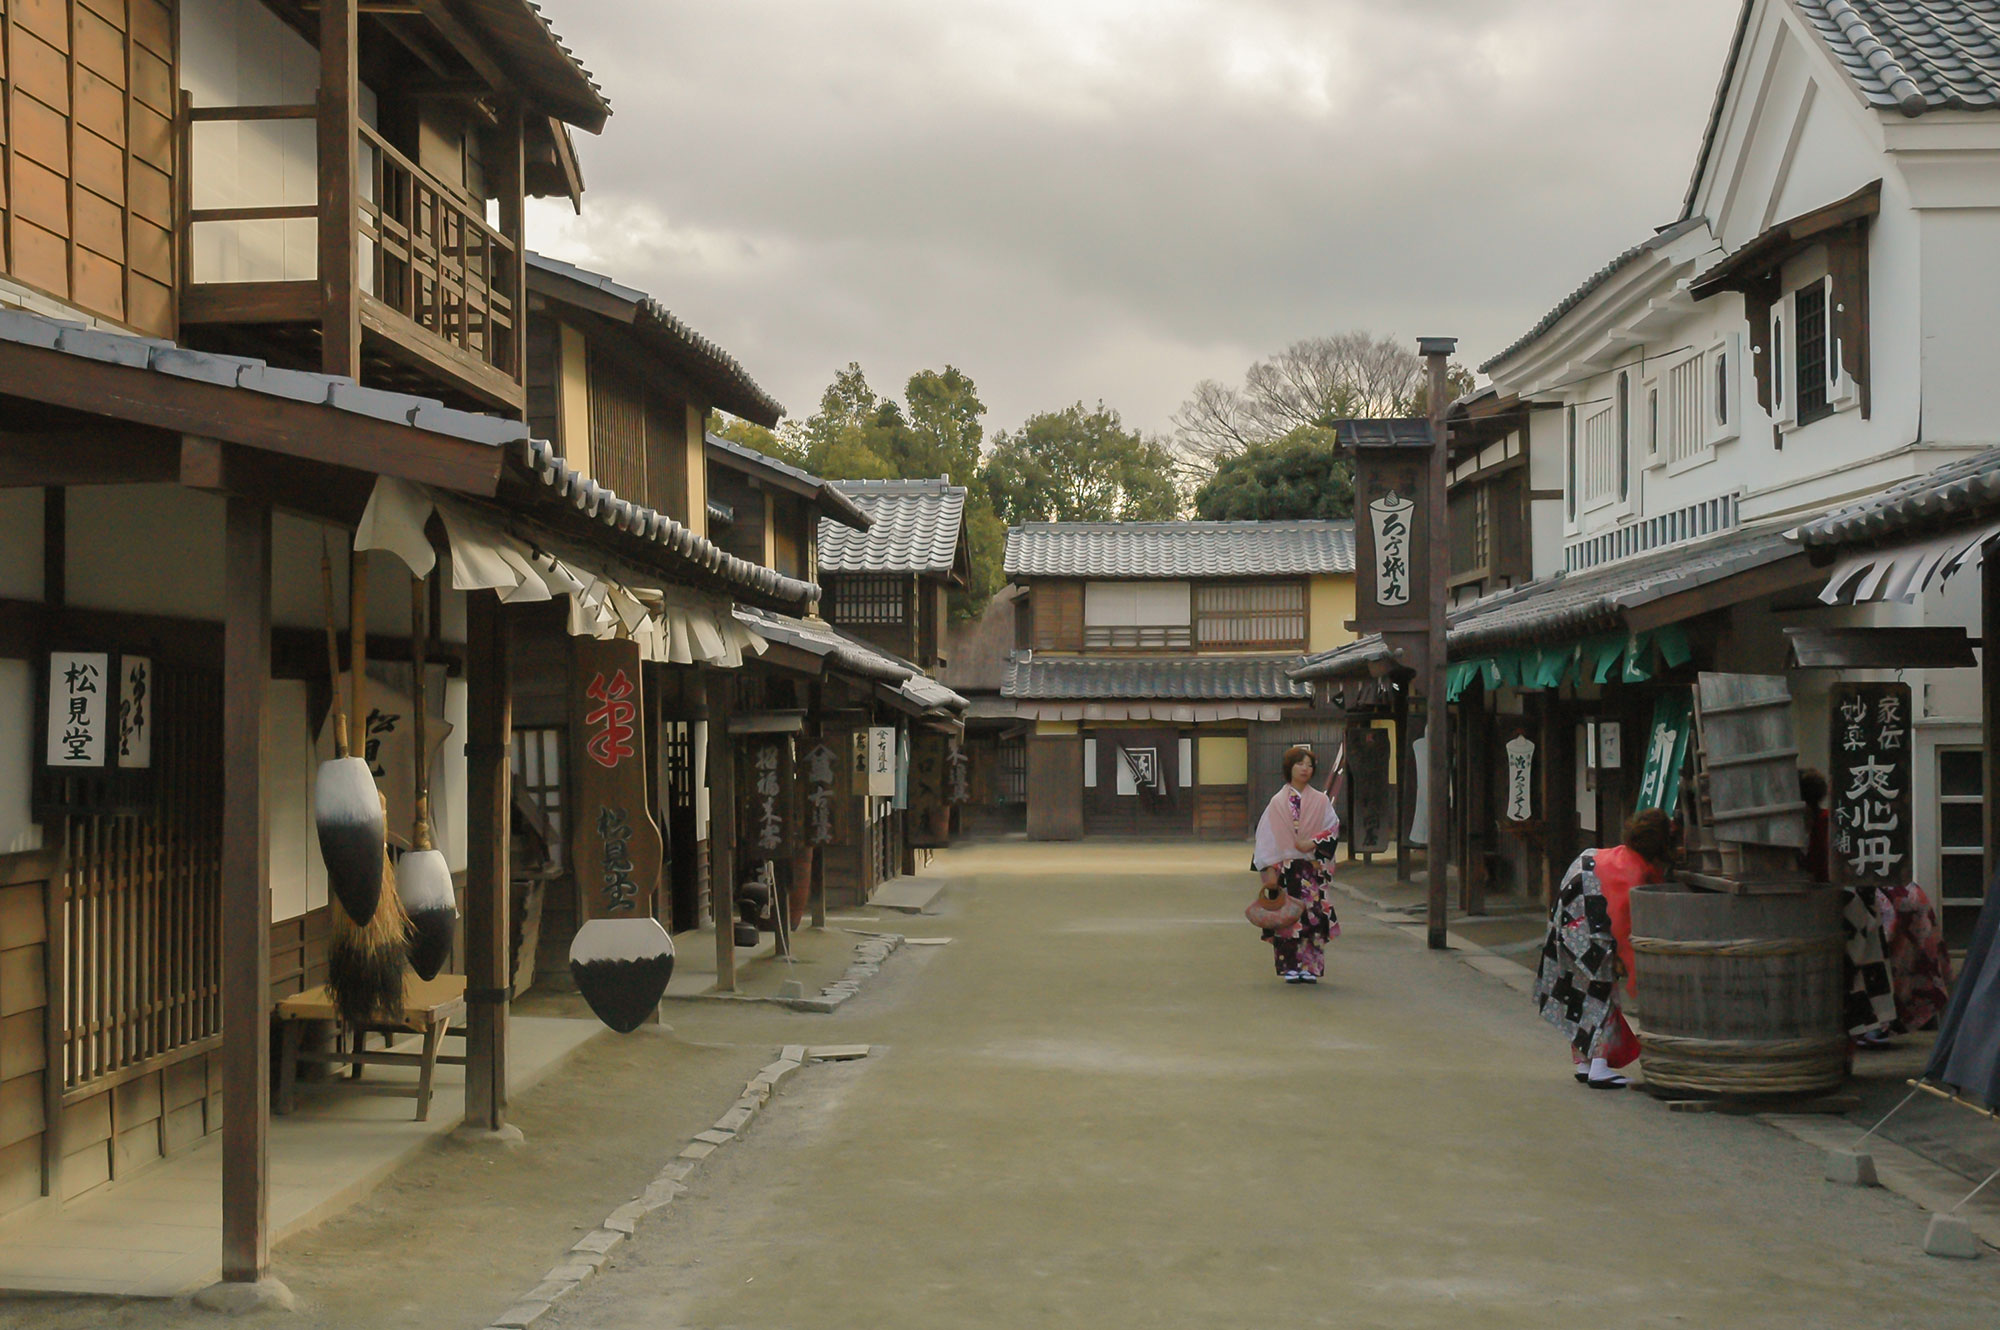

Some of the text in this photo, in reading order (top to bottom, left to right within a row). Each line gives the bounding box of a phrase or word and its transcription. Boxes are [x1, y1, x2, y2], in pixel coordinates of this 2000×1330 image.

[62, 661, 99, 761] 松見堂
[585, 668, 636, 769] 筆
[1841, 695, 1868, 751] 妙薬
[1877, 696, 1905, 750] 家伝
[595, 804, 639, 912] 松見堂
[1845, 755, 1904, 877] 爽心丹
